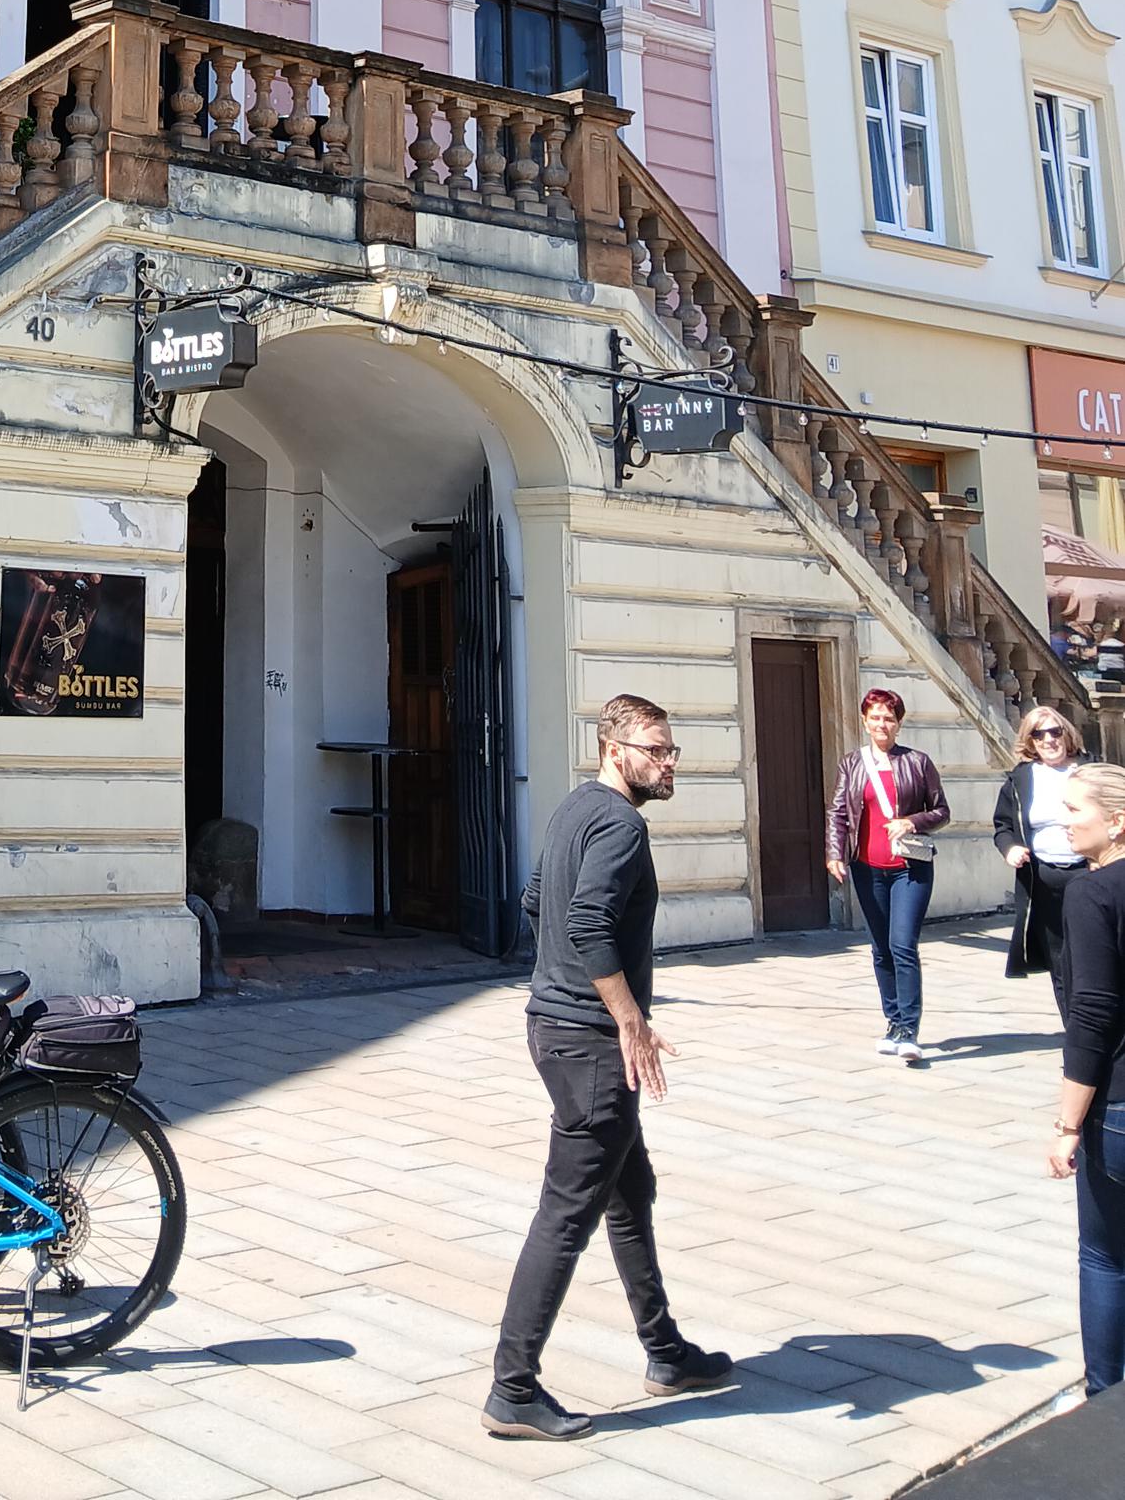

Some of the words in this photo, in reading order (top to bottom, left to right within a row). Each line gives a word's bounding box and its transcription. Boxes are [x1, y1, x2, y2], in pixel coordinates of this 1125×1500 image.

[25, 316, 55, 342] 40
[150, 329, 224, 365] BOTTLES
[161, 366, 176, 376] BAR
[185, 362, 213, 373] BISTRO
[643, 418, 674, 433] BAR
[58, 673, 139, 699] BOTTLES
[140, 1129, 177, 1202] CONTINENTAL
